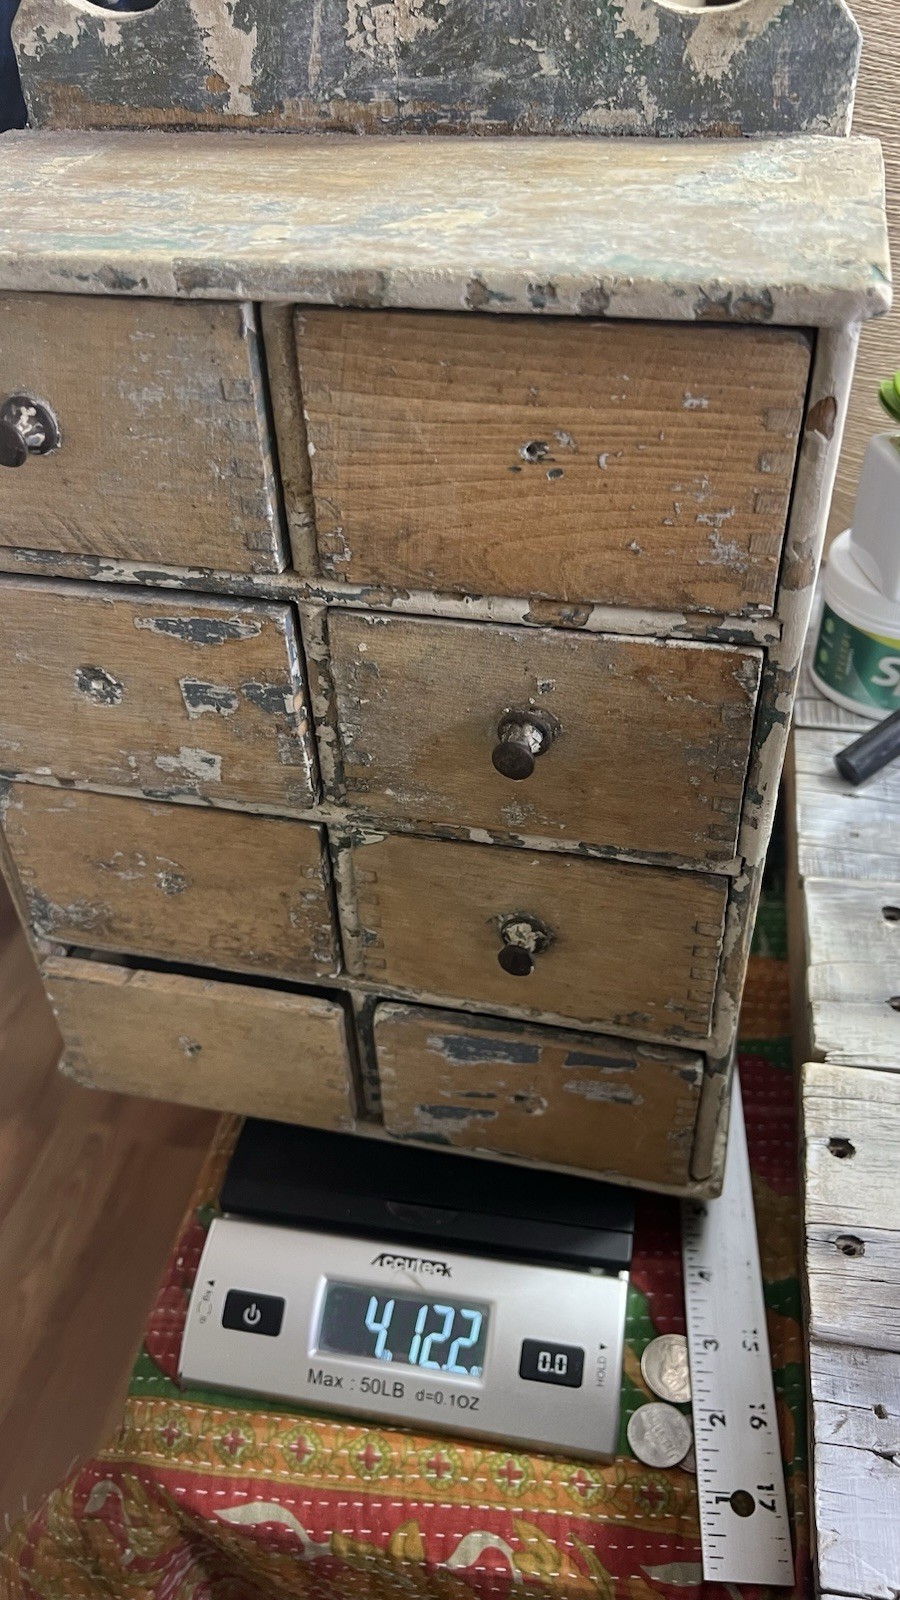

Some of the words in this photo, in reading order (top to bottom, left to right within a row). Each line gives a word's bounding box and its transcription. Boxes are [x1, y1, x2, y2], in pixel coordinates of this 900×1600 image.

[703, 1338, 720, 1352] 3
[537, 1351, 568, 1375] 0.0
[596, 1355, 607, 1388] HOLD
[307, 1368, 344, 1389] Max
[360, 1377, 405, 1399] 50LB
[708, 1412, 727, 1428] 2
[757, 1484, 777, 1513] 17
